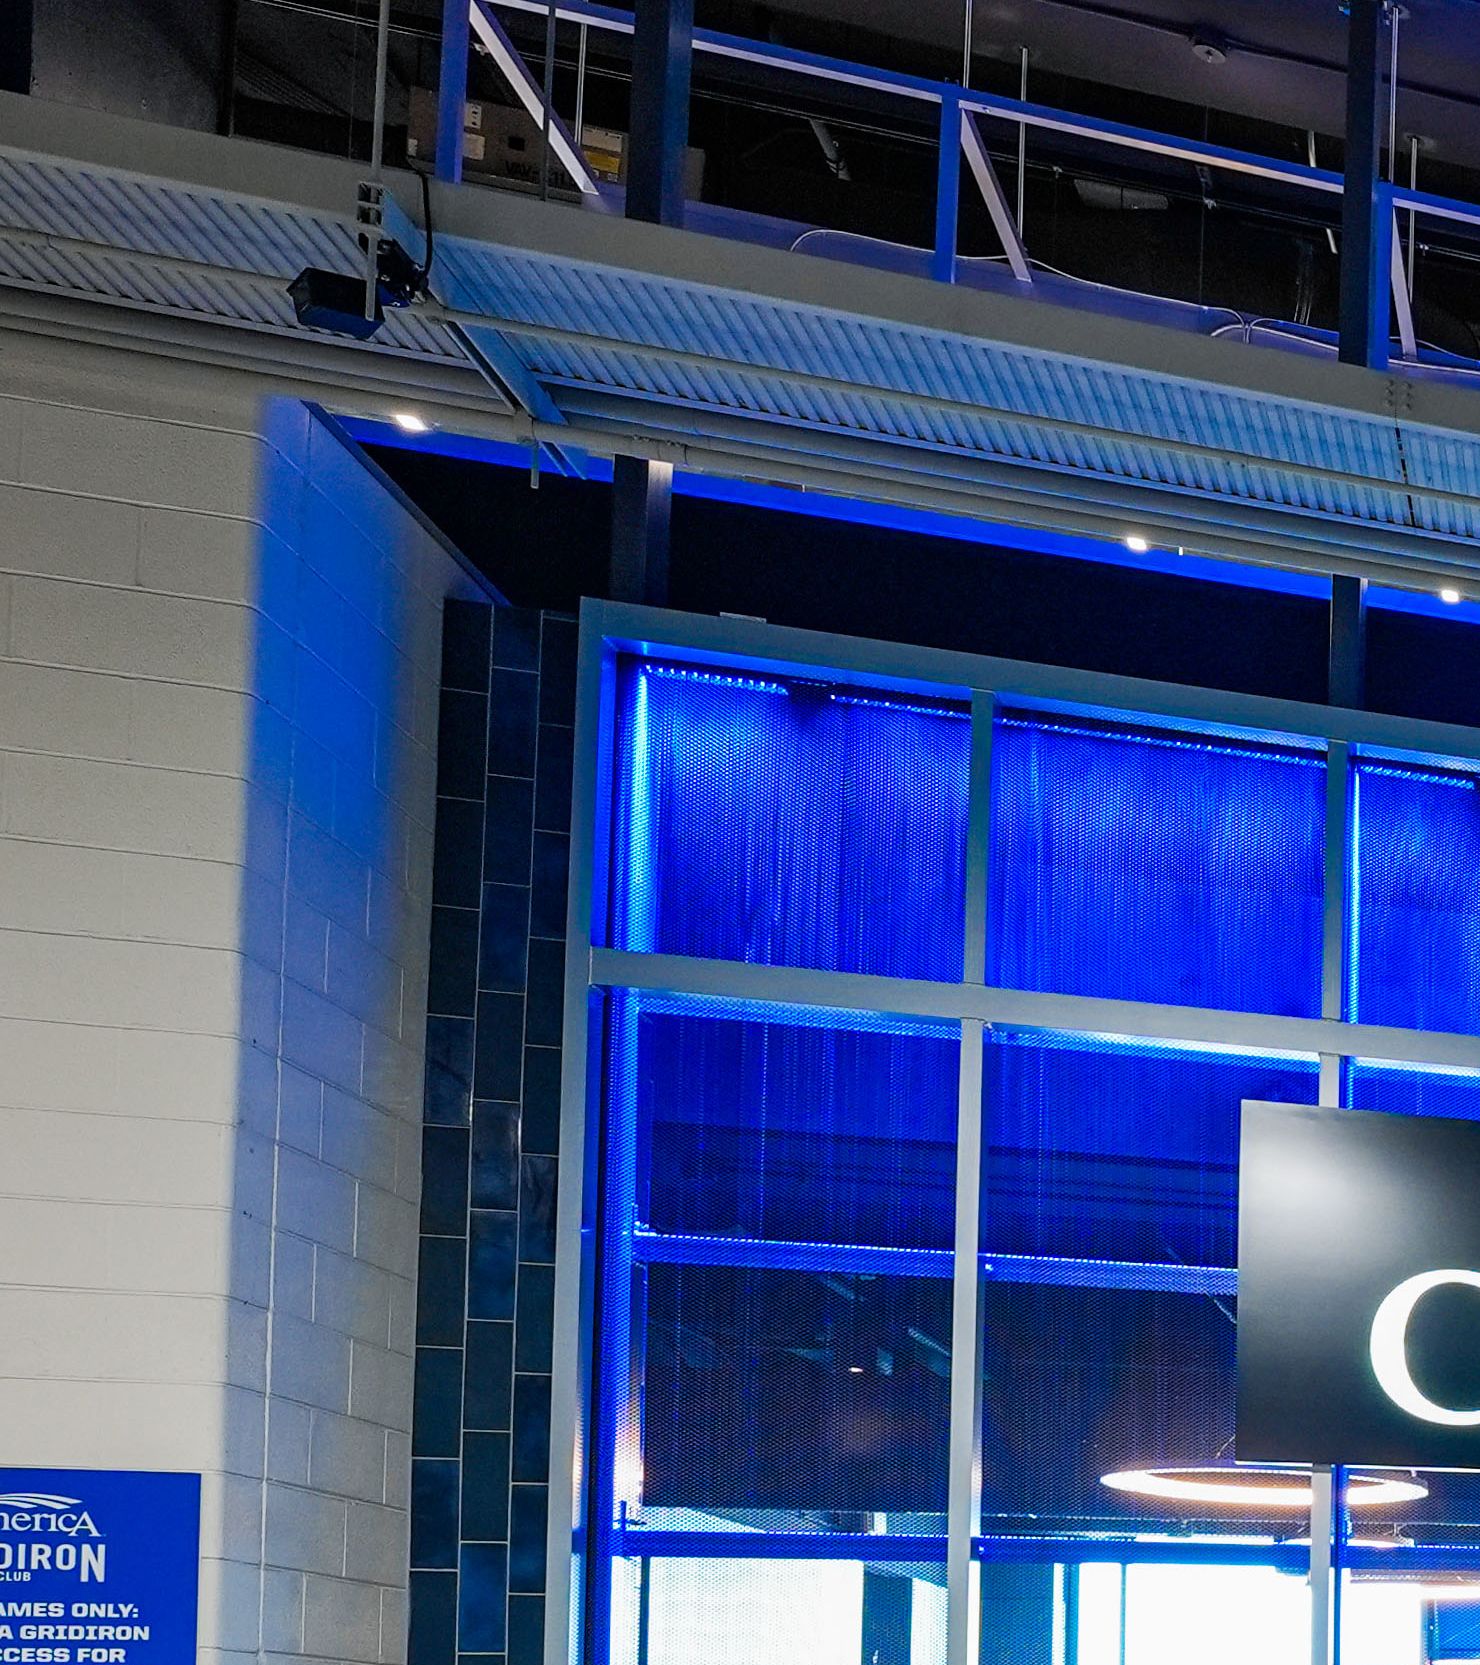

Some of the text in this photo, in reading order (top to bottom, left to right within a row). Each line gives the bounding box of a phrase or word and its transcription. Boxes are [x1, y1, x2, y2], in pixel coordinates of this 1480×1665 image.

[71, 1603, 139, 1619] ONLY:
[19, 1625, 150, 1641] GRIDIRON
[0, 1648, 126, 1663] CESS FOR
